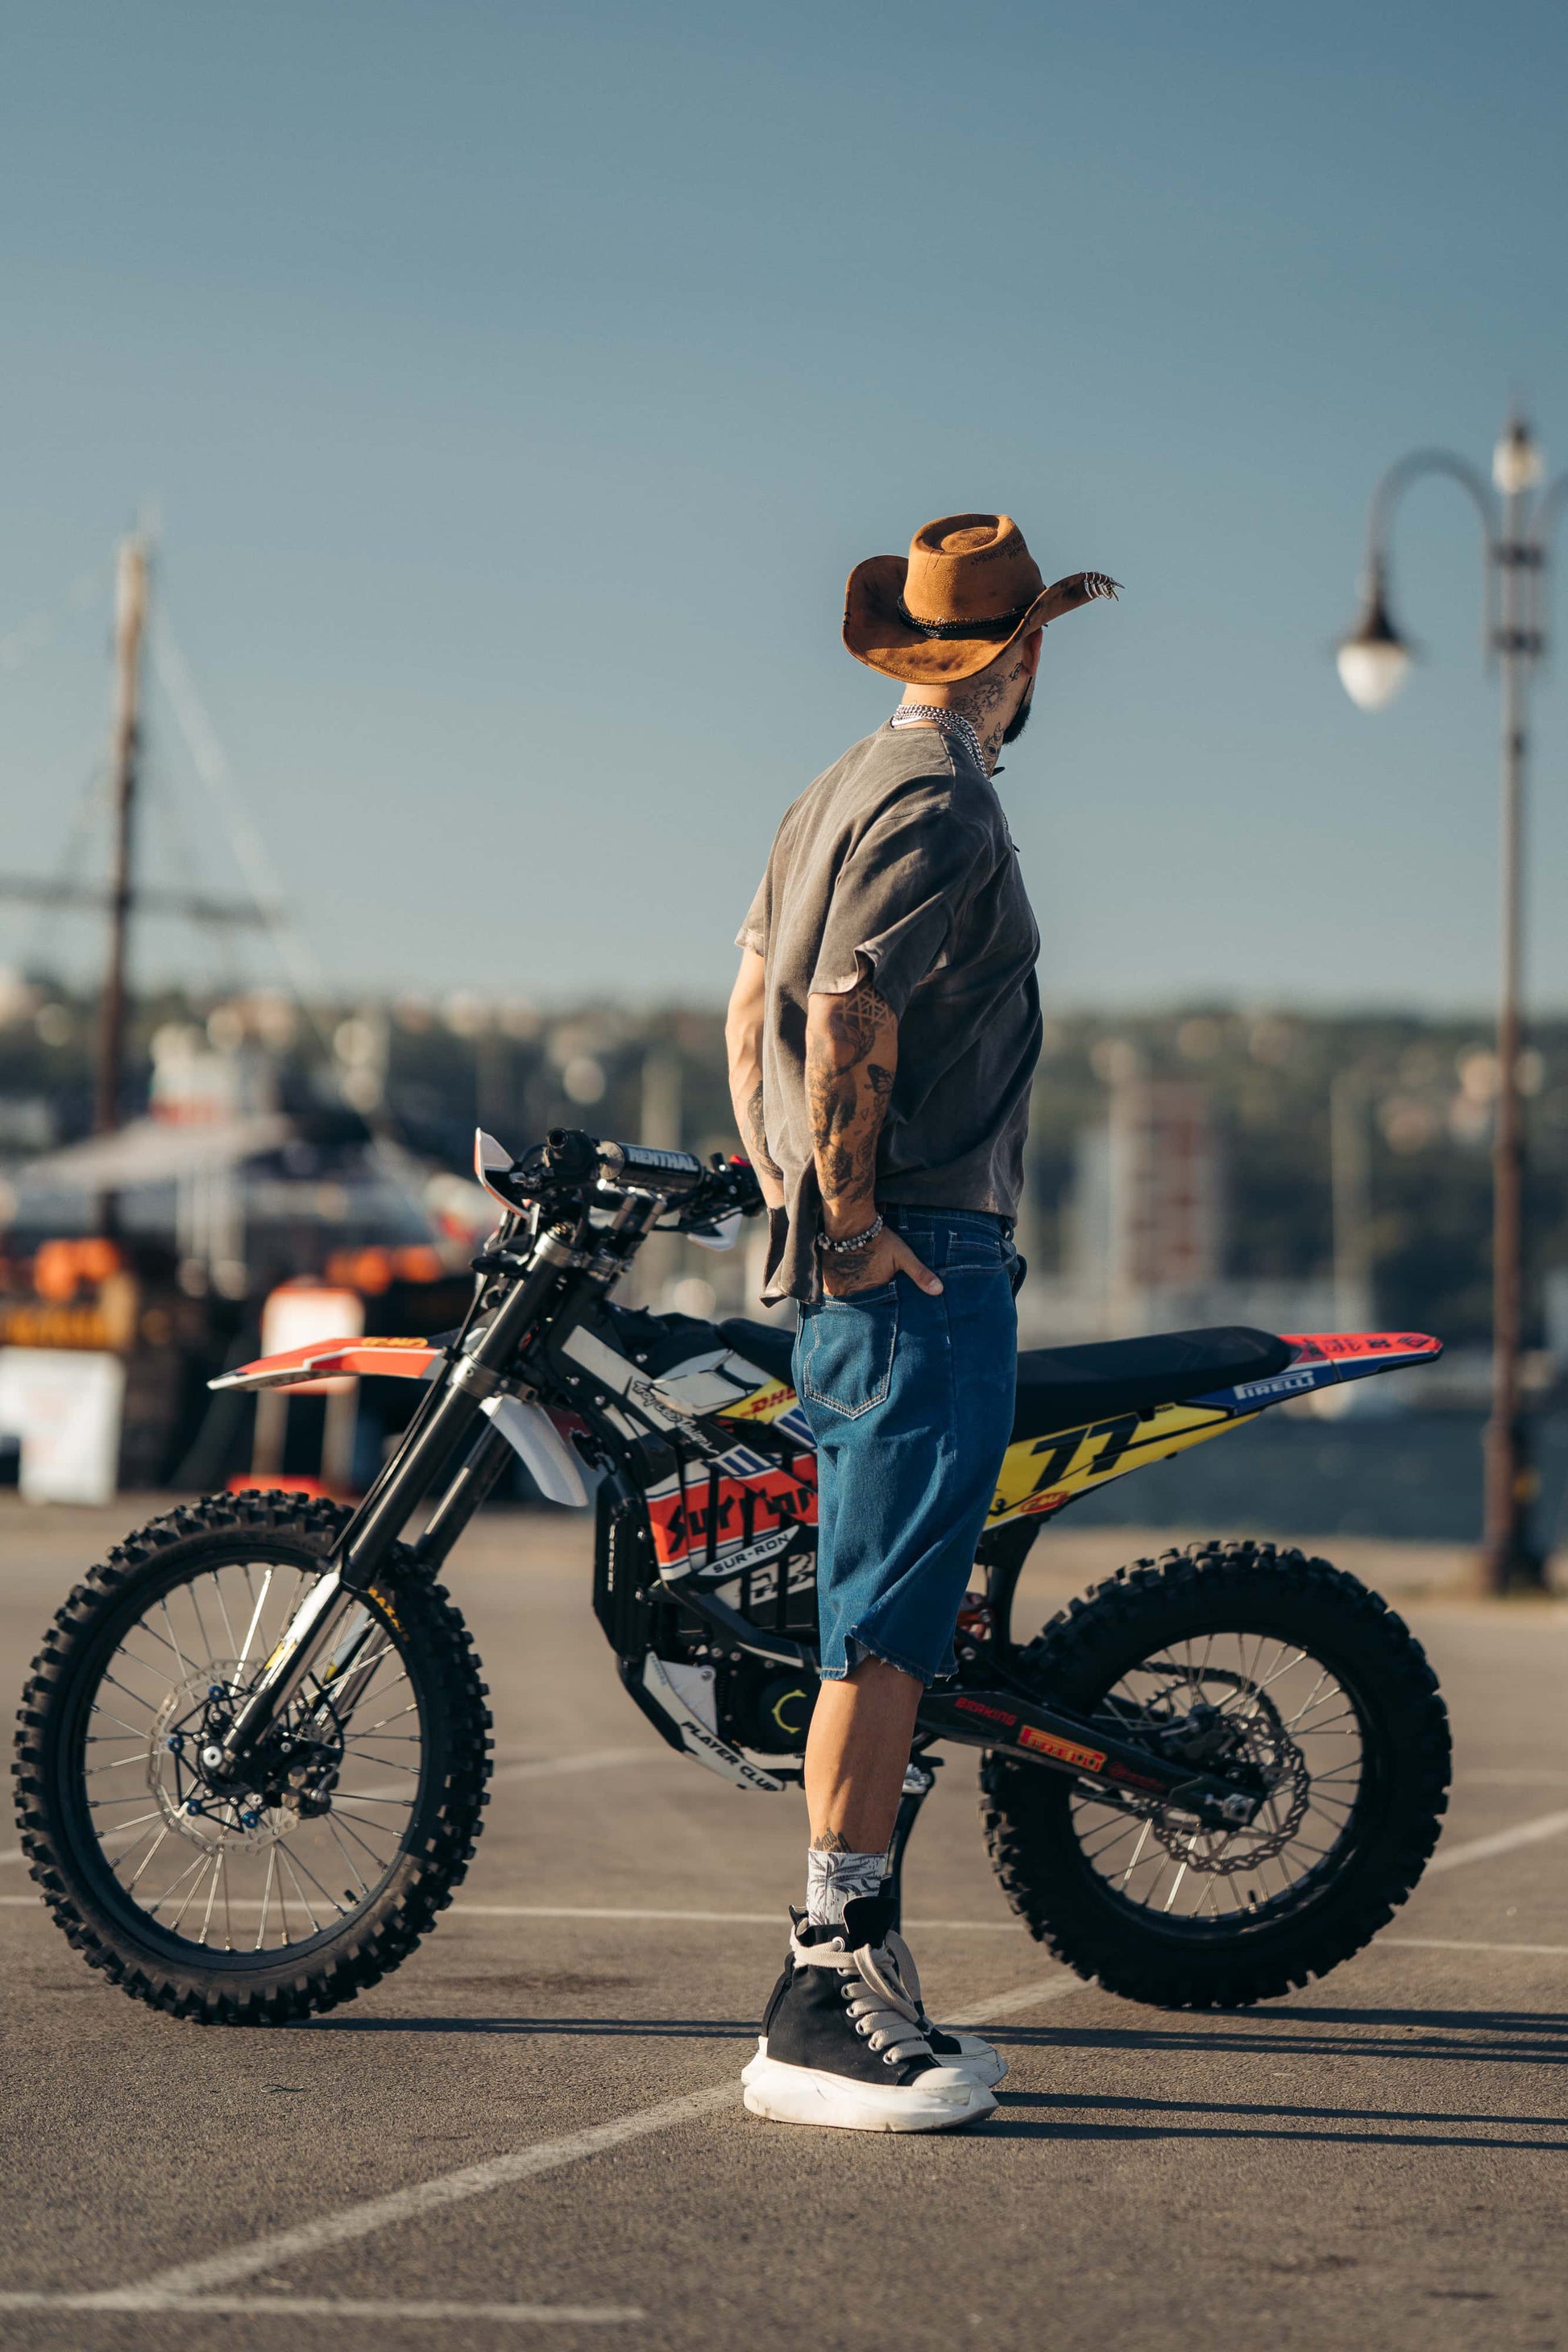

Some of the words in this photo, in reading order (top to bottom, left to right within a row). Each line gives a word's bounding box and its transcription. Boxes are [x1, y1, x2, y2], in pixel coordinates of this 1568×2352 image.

[628, 1147, 699, 1173] RENTHAL
[750, 1387, 797, 1414] DHL
[1233, 1370, 1316, 1400] PIRELLI
[1030, 1411, 1142, 1493] 77
[713, 1533, 790, 1574] SUR-RON
[954, 1696, 1017, 1727] BRAKING
[681, 1721, 740, 1766] PLAYER
[1018, 1725, 1107, 1773] PIRELLI
